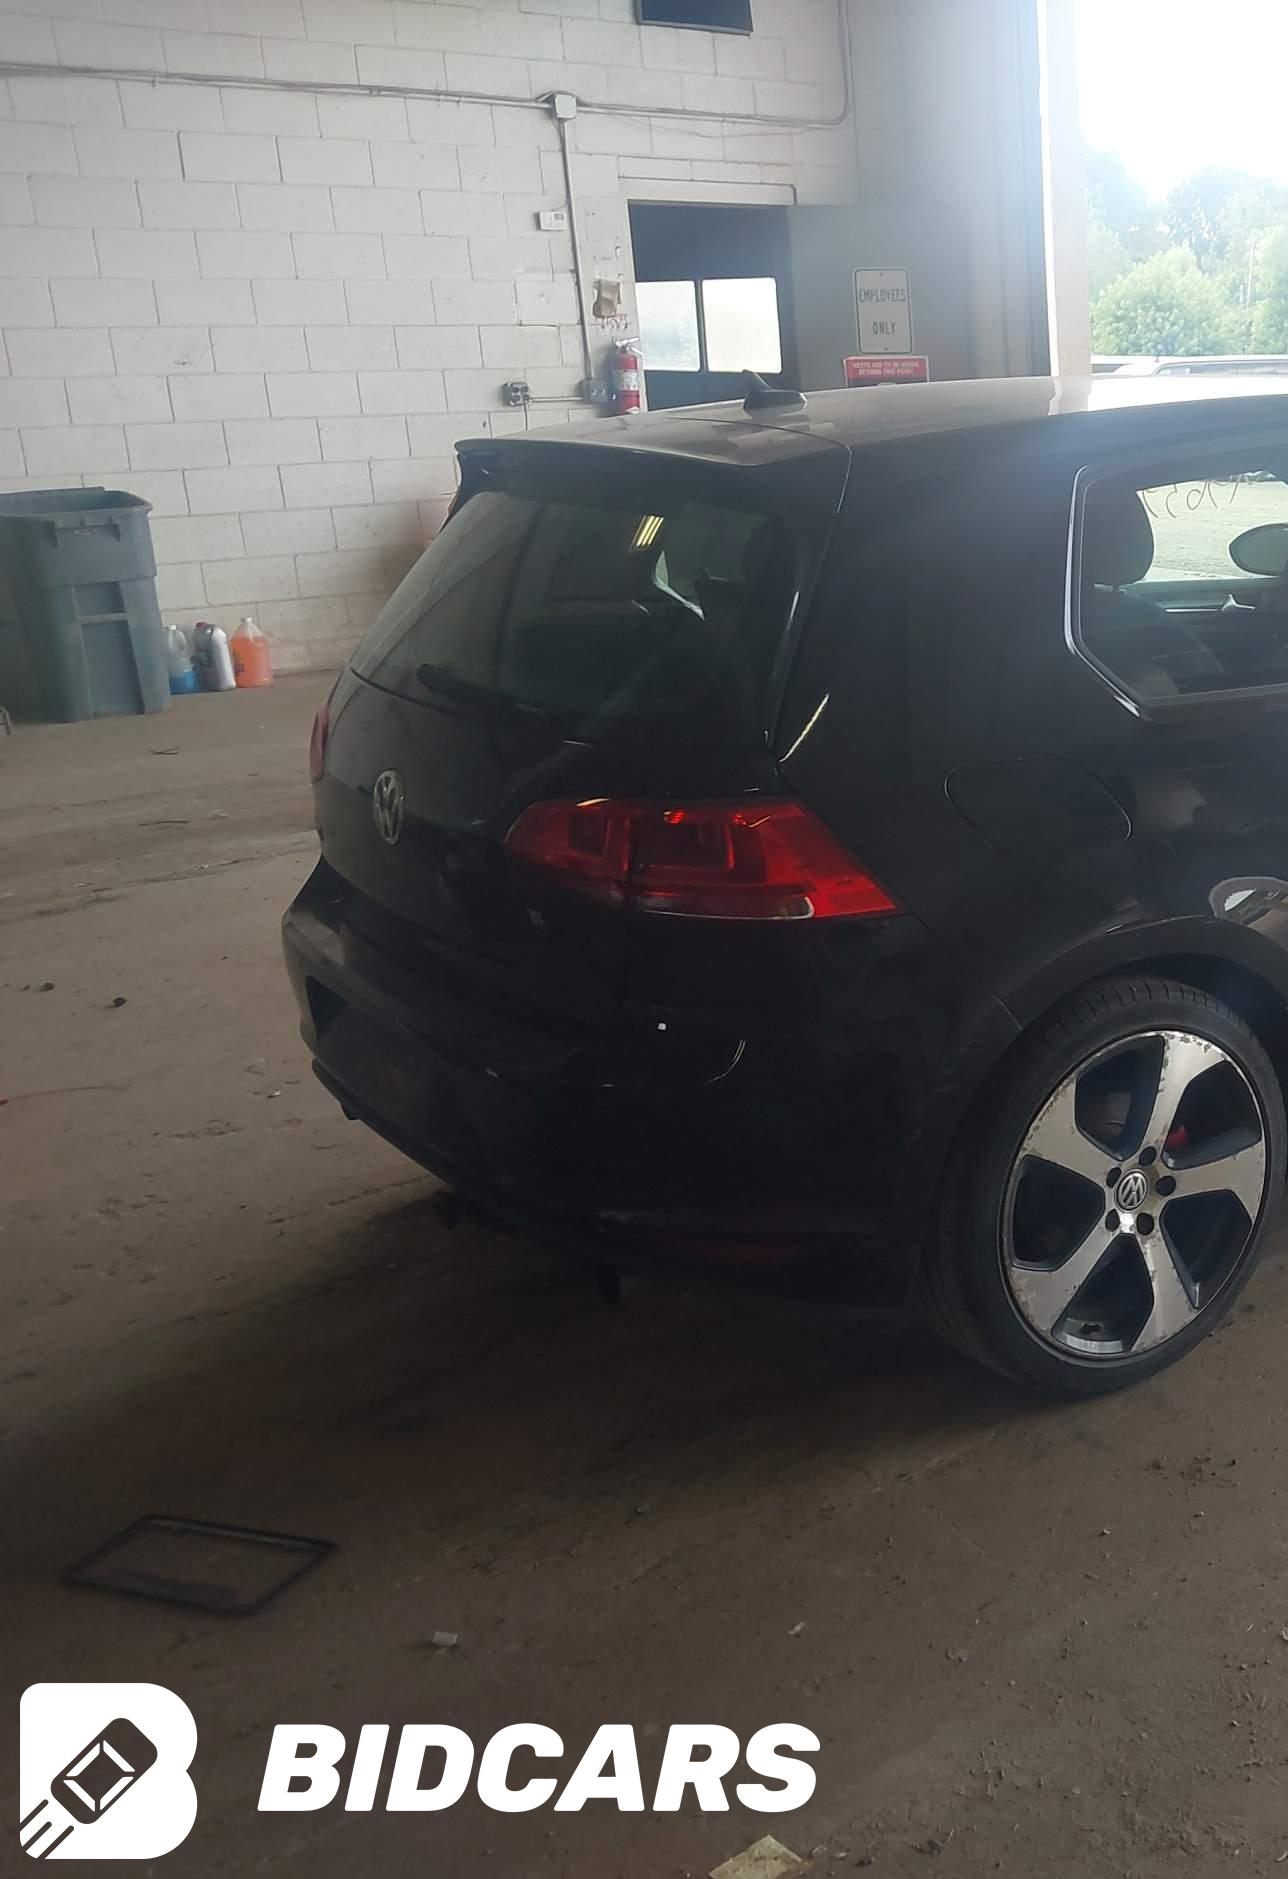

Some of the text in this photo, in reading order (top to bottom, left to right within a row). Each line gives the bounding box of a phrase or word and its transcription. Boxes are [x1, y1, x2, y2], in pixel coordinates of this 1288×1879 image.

[858, 288, 907, 303] EMPLOYEES
[872, 321, 897, 335] ONLY
[1118, 1171, 1148, 1211] VW
